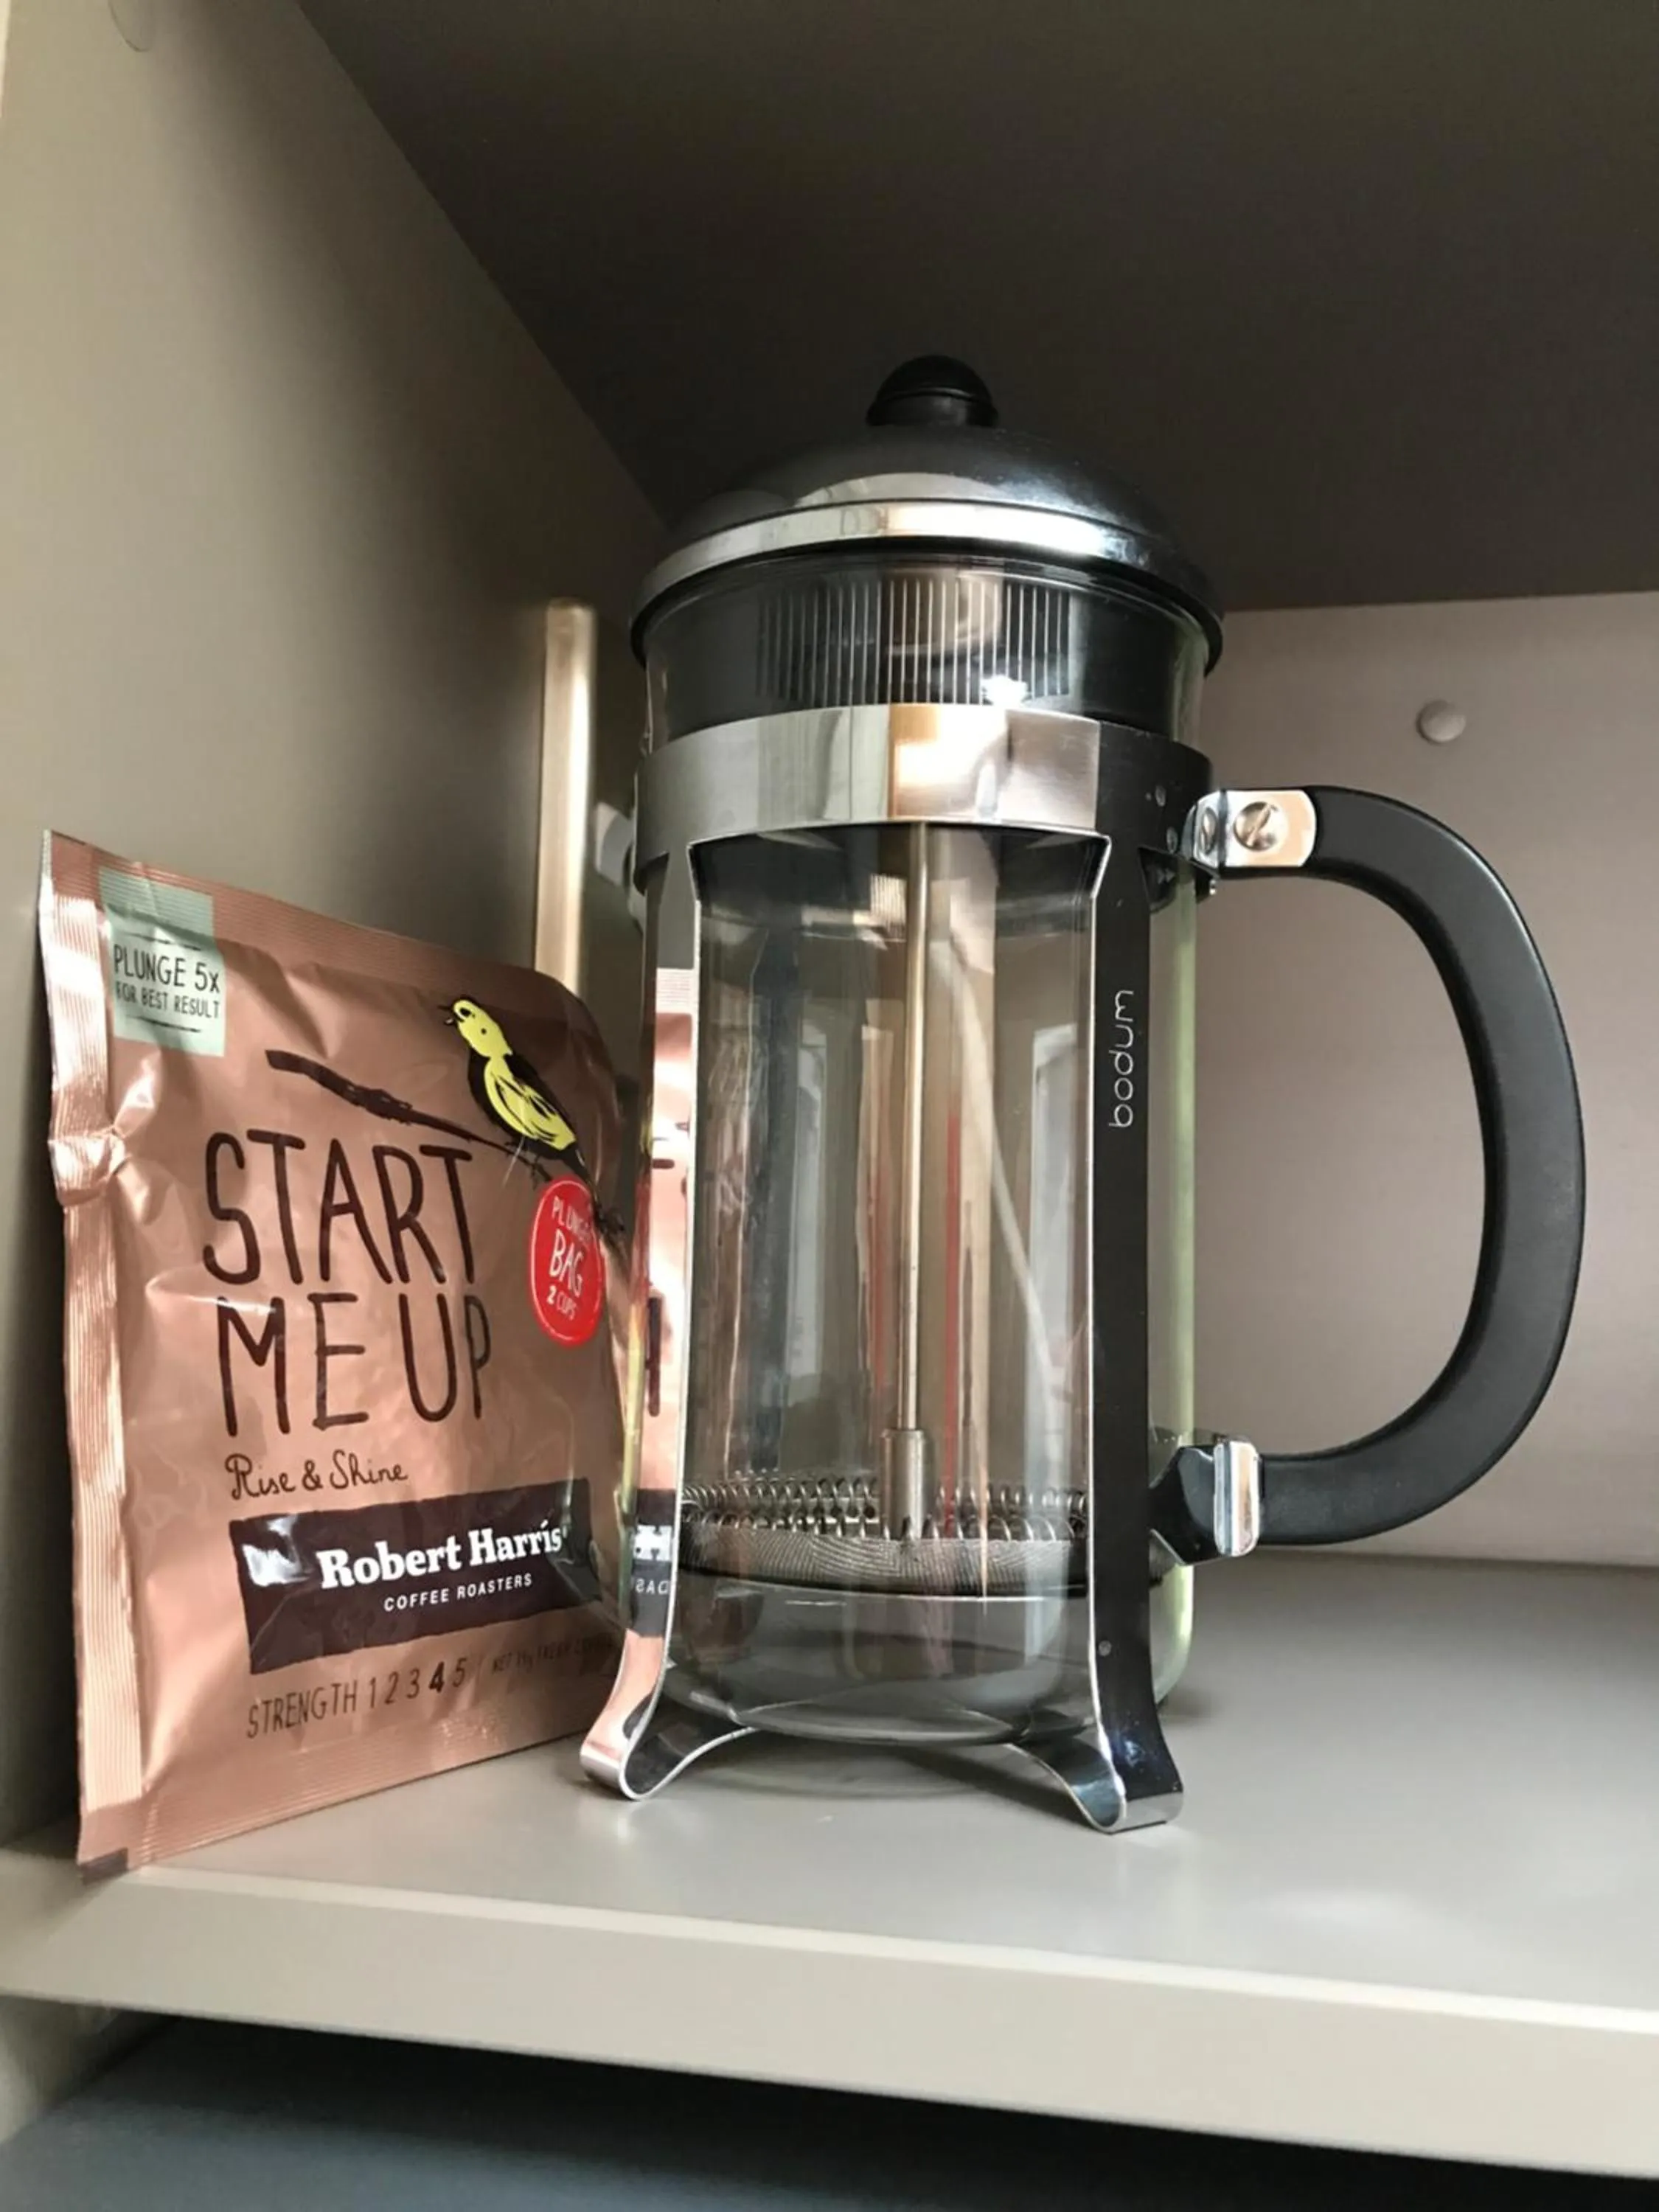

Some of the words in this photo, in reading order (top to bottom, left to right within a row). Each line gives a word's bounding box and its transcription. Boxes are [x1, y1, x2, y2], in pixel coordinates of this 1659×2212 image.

[114, 944, 187, 988] PLUNGE
[114, 981, 138, 1004] FOR
[141, 990, 169, 1011] BEST
[173, 995, 220, 1018] RESULT
[1108, 990, 1134, 1128] bodum
[202, 1129, 473, 1284] START
[546, 1284, 557, 1305] 2
[549, 1228, 584, 1298] BAG
[217, 1292, 370, 1437] ME
[398, 1293, 493, 1423] UP
[224, 1453, 298, 1500] Rise
[301, 1458, 324, 1490] &
[327, 1448, 409, 1490] Shine
[316, 1534, 462, 1589] Robert
[467, 1520, 563, 1567] Harris
[383, 1588, 450, 1613] COFFEE
[456, 1573, 533, 1600] ROASTERS
[247, 1680, 358, 1739] STRENGTH
[369, 1676, 378, 1710] 1
[384, 1671, 400, 1705] 2
[406, 1668, 421, 1700] 3
[428, 1660, 445, 1694] 4
[452, 1658, 467, 1688] 5
